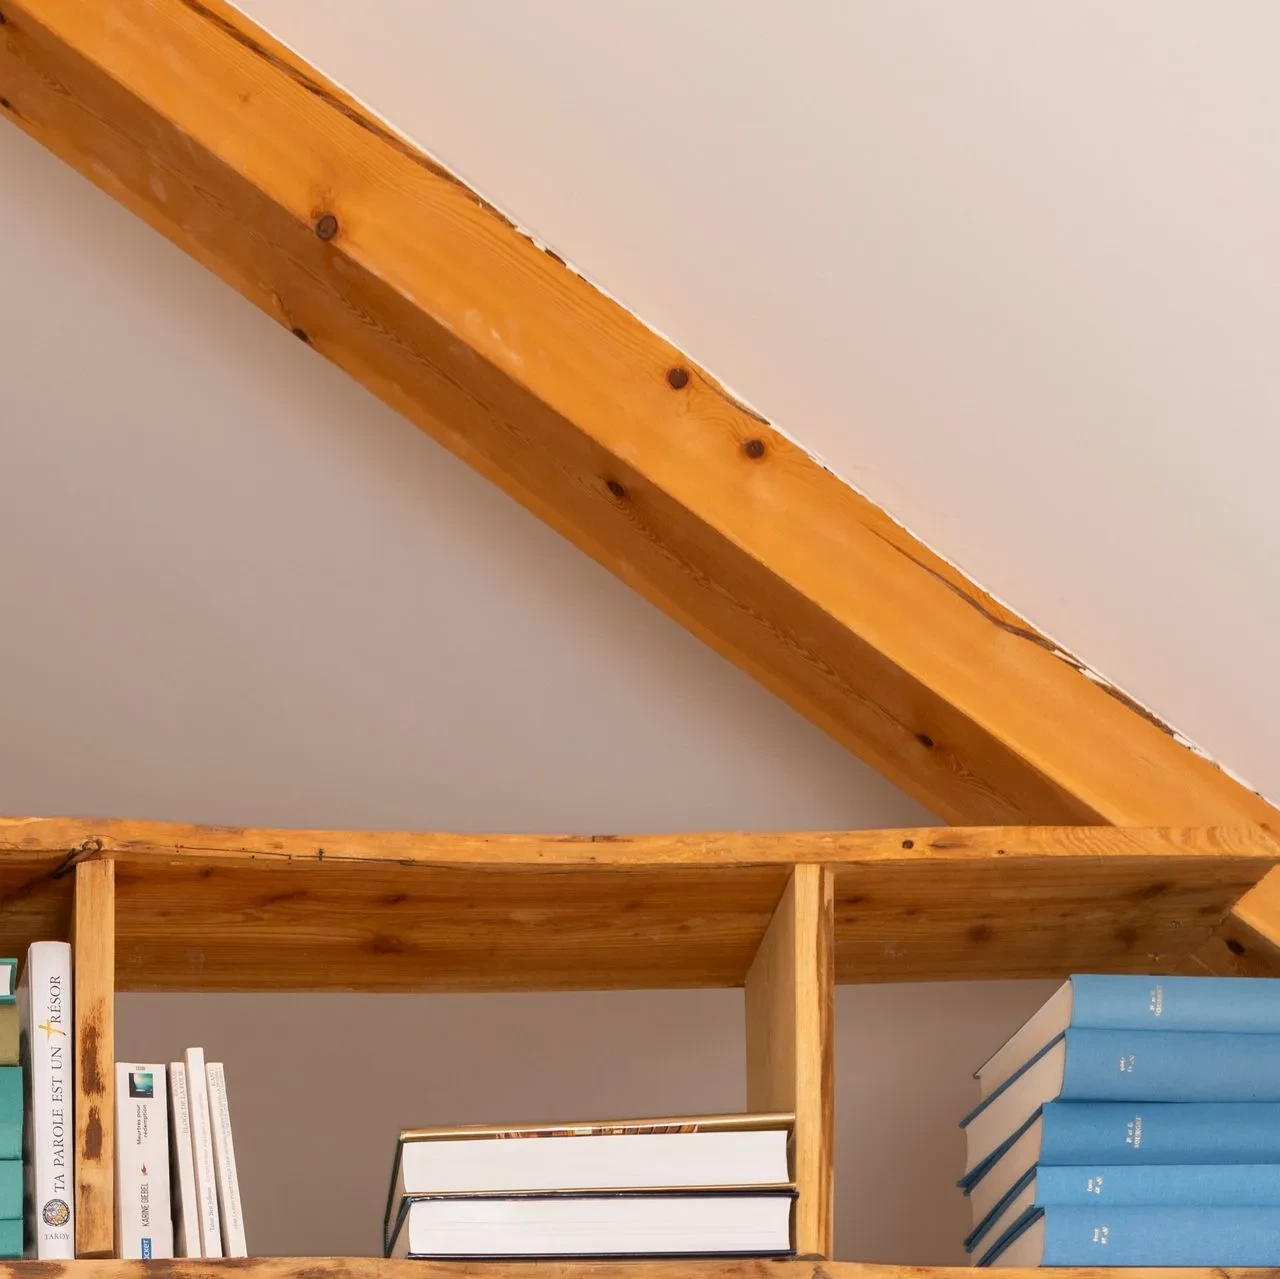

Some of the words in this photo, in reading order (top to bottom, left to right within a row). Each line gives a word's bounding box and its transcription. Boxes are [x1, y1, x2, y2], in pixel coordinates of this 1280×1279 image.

[38, 975, 66, 1042] TRÉSOR
[51, 1046, 62, 1071] UN
[52, 1076, 64, 1103] EST
[53, 1109, 65, 1168] PAROLE
[54, 1173, 65, 1193] TA
[44, 1233, 69, 1241] TARDY
